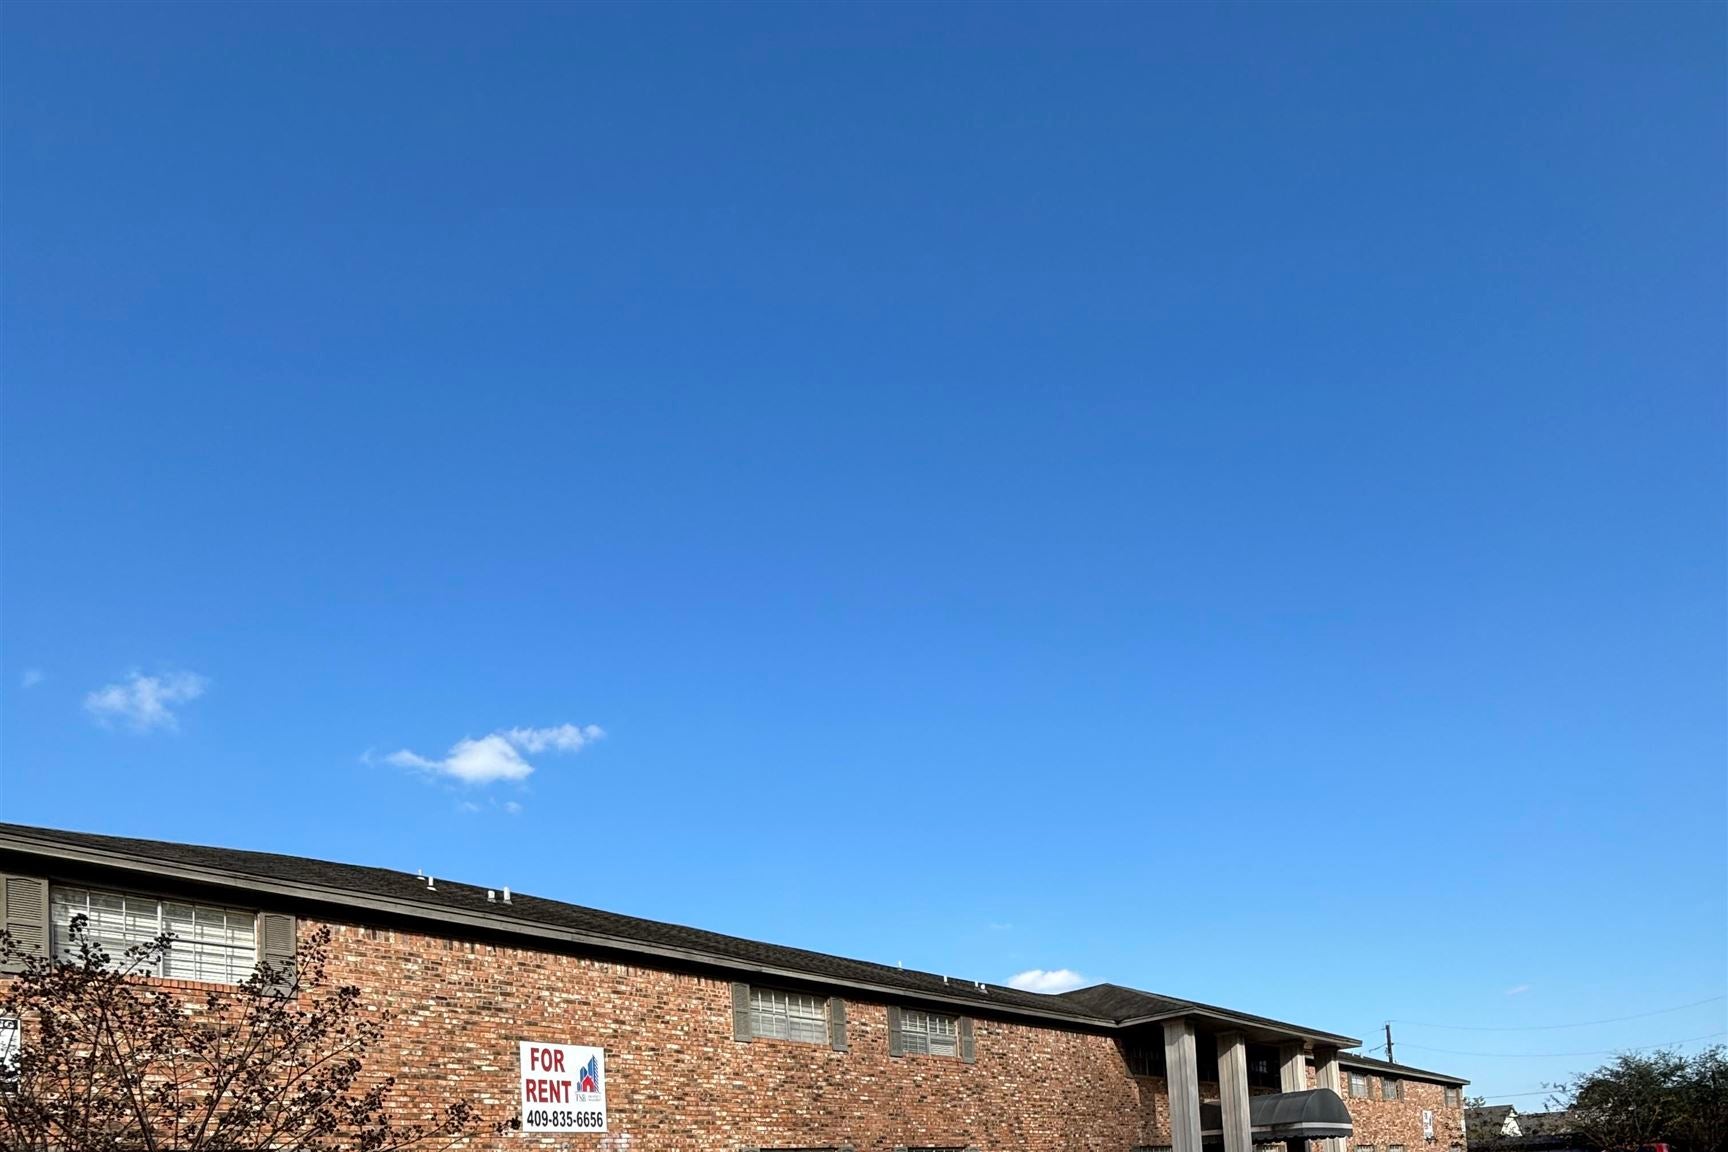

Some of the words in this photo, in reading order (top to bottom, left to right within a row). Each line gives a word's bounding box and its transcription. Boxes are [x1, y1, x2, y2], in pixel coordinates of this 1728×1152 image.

[530, 1047, 566, 1073] FOR
[525, 1078, 572, 1104] RENT
[526, 1109, 604, 1128] 409-835-6656
